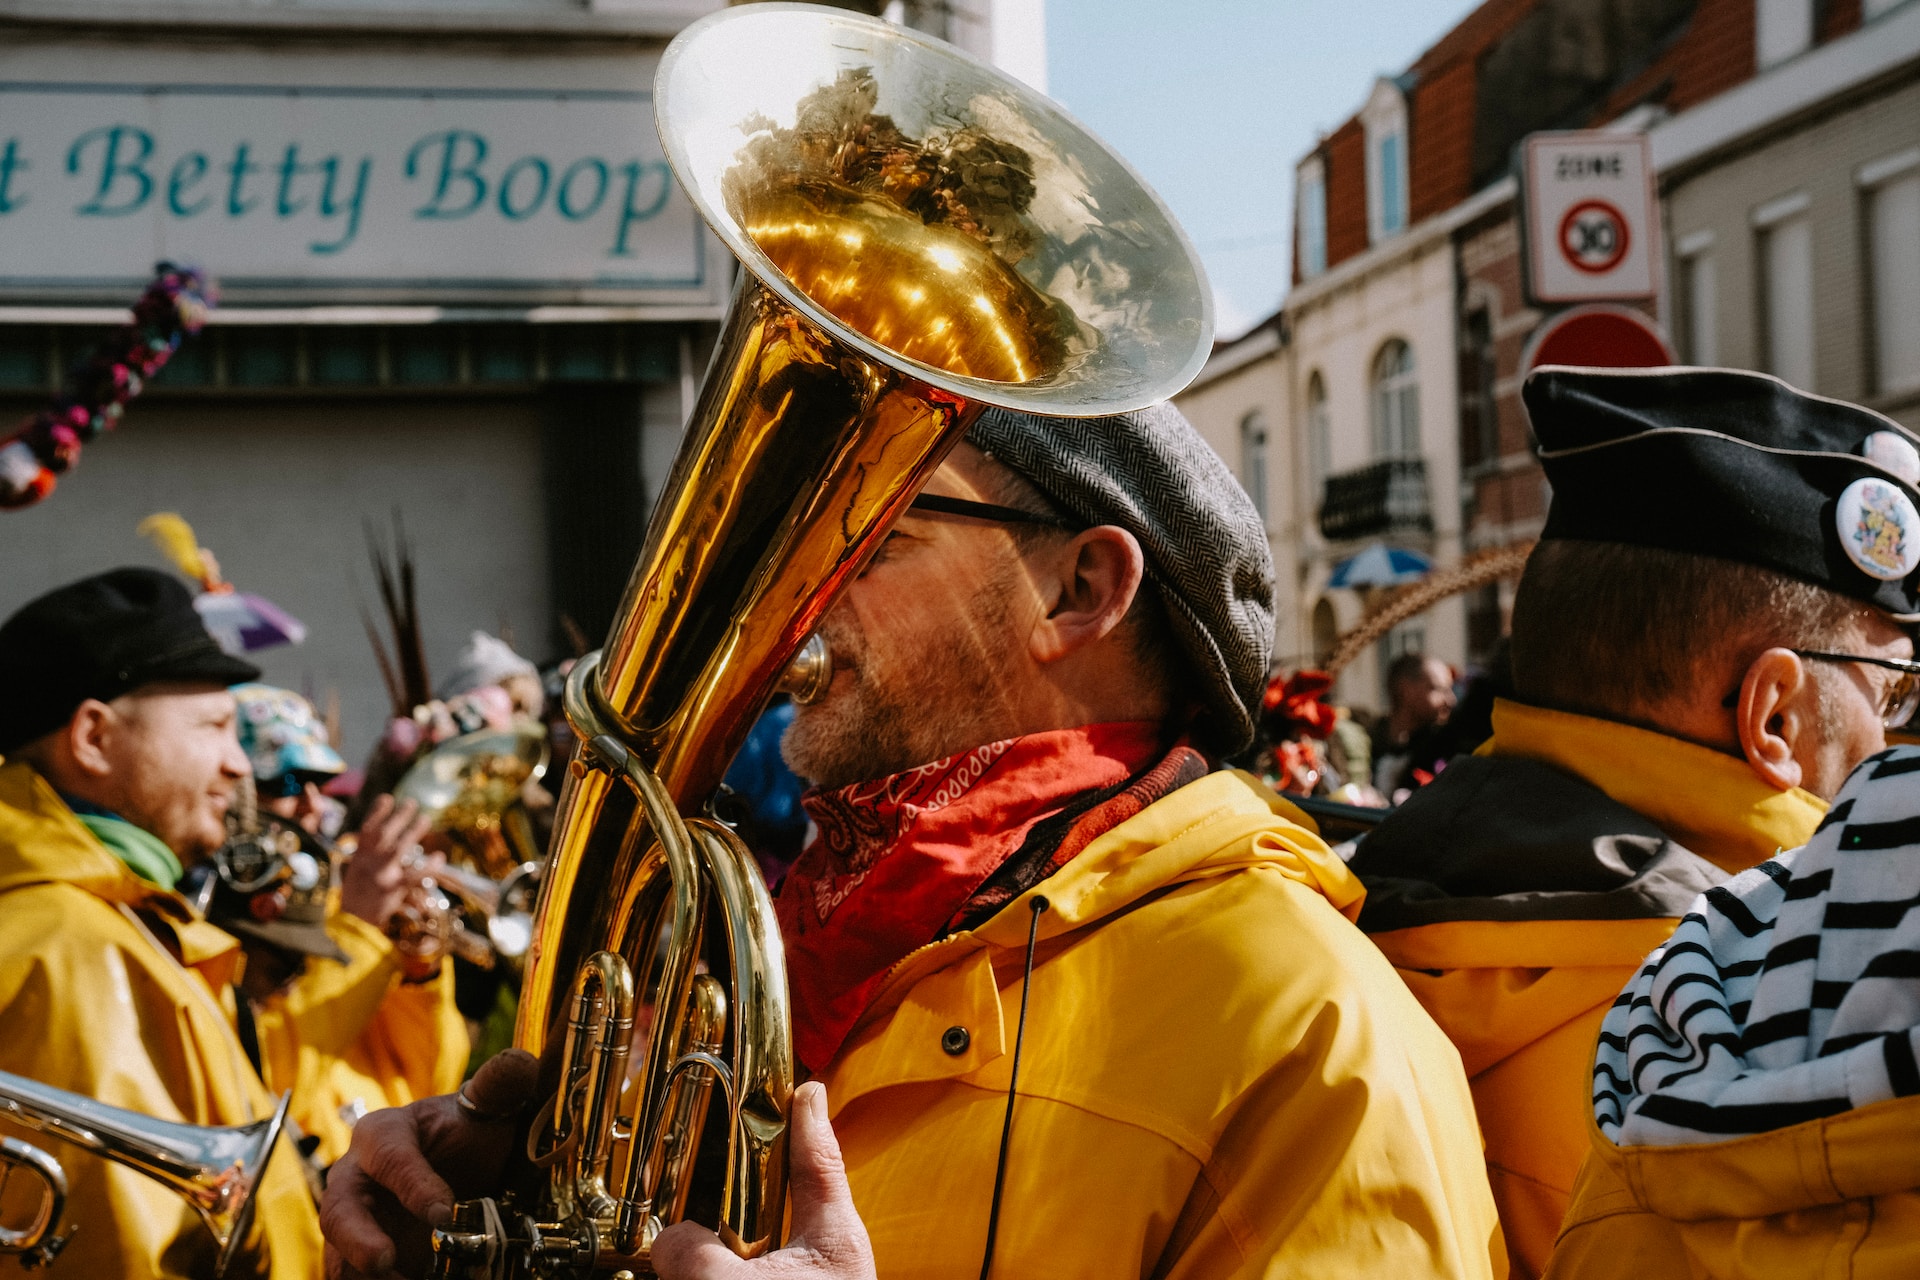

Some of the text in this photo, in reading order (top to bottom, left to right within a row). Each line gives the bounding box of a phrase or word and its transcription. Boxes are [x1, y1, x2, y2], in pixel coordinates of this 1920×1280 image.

[66, 125, 372, 254] Betty
[404, 130, 673, 257] Boop
[1557, 155, 1622, 178] ZONE
